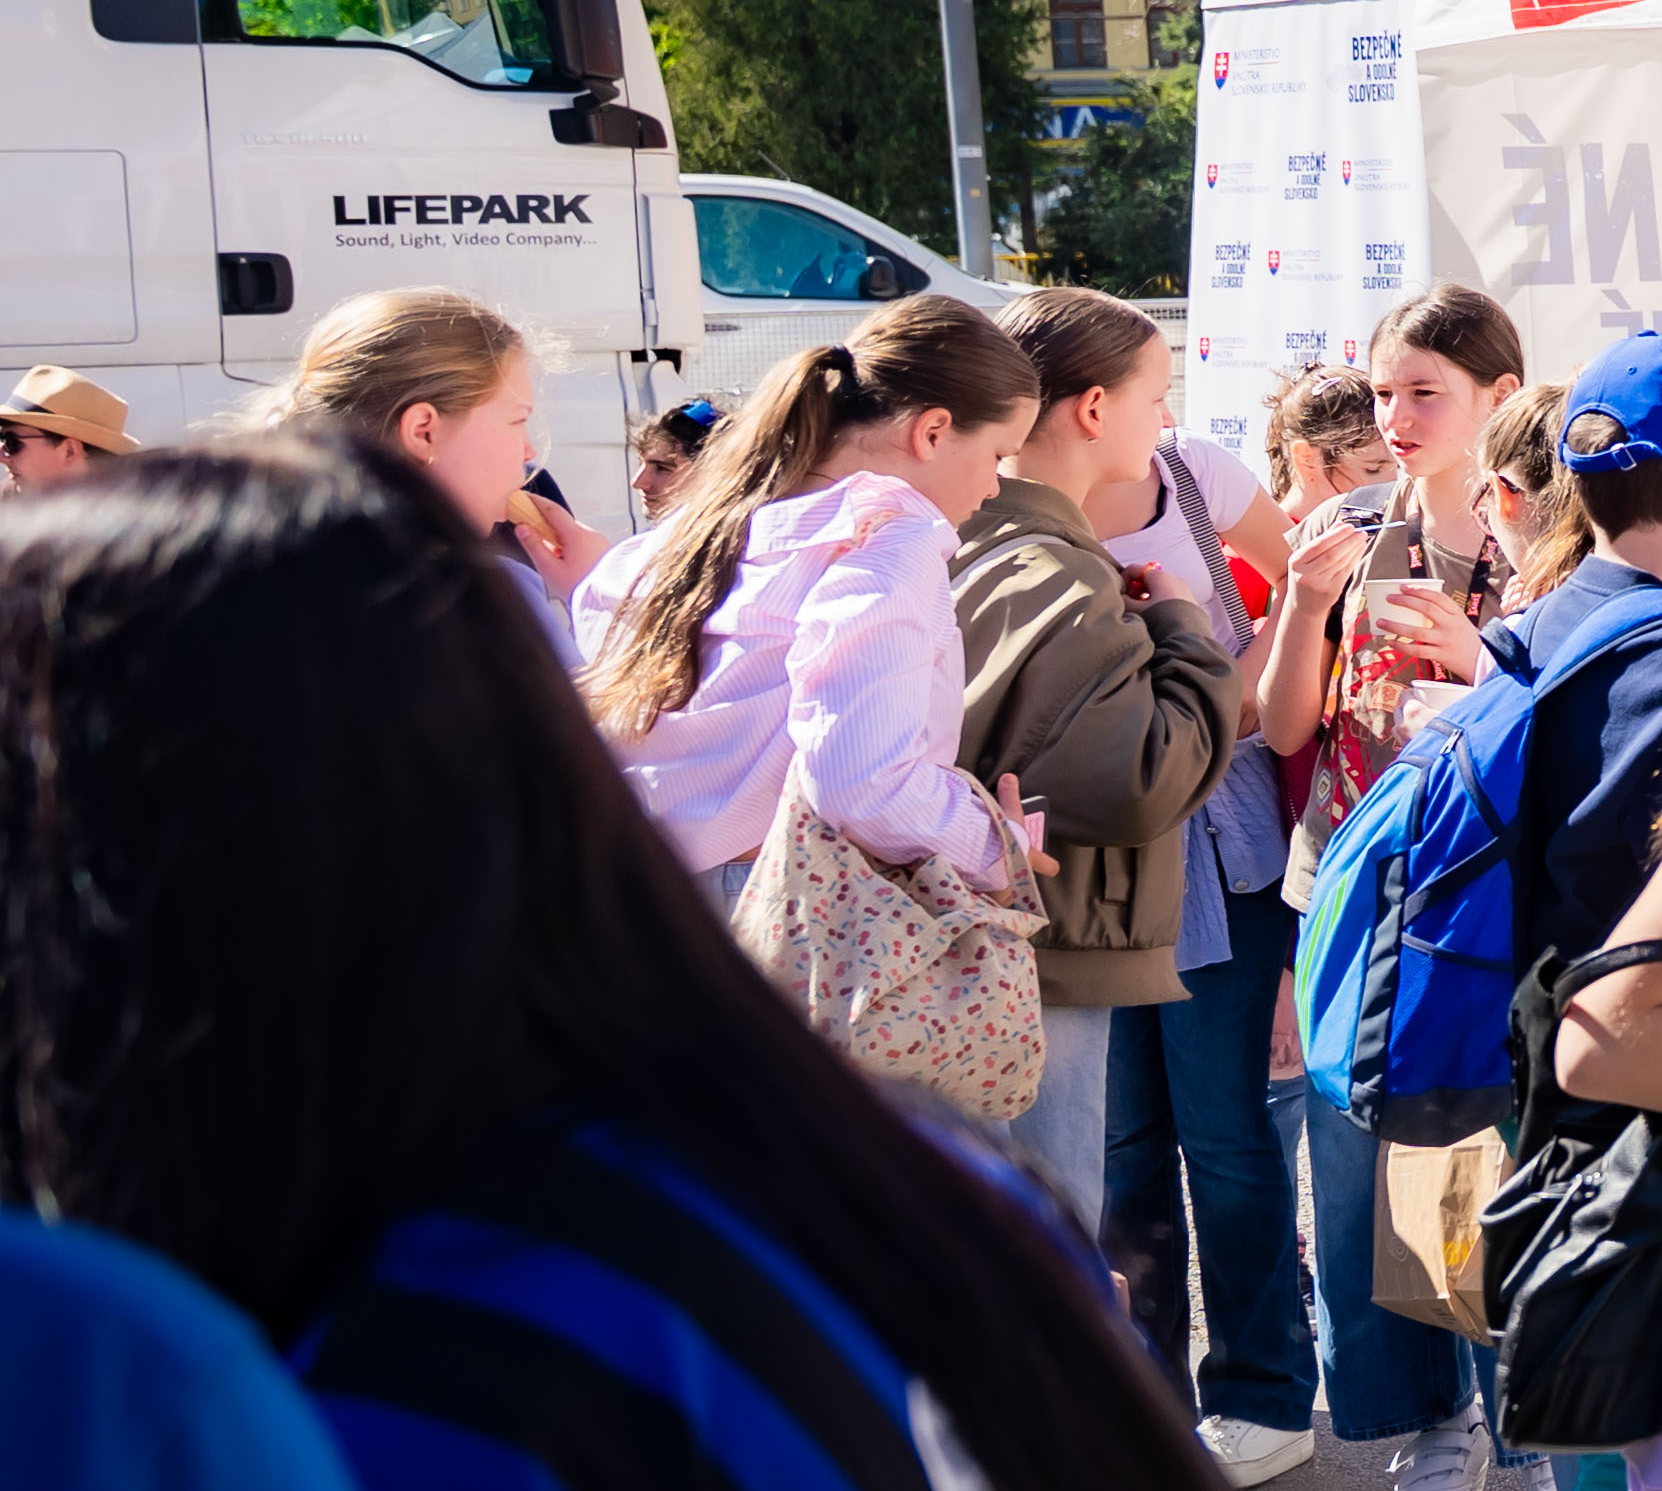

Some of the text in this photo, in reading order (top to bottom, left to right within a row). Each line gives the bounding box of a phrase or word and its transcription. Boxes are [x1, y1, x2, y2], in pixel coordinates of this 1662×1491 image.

[1352, 30, 1402, 61] BEZPEČNÉ
[1366, 61, 1397, 81] A ODOLNÉ
[1348, 83, 1396, 103] SLOVENSKO
[332, 194, 594, 226] LIFEPARK
[335, 232, 597, 250] Sound, Light, Video Company...
